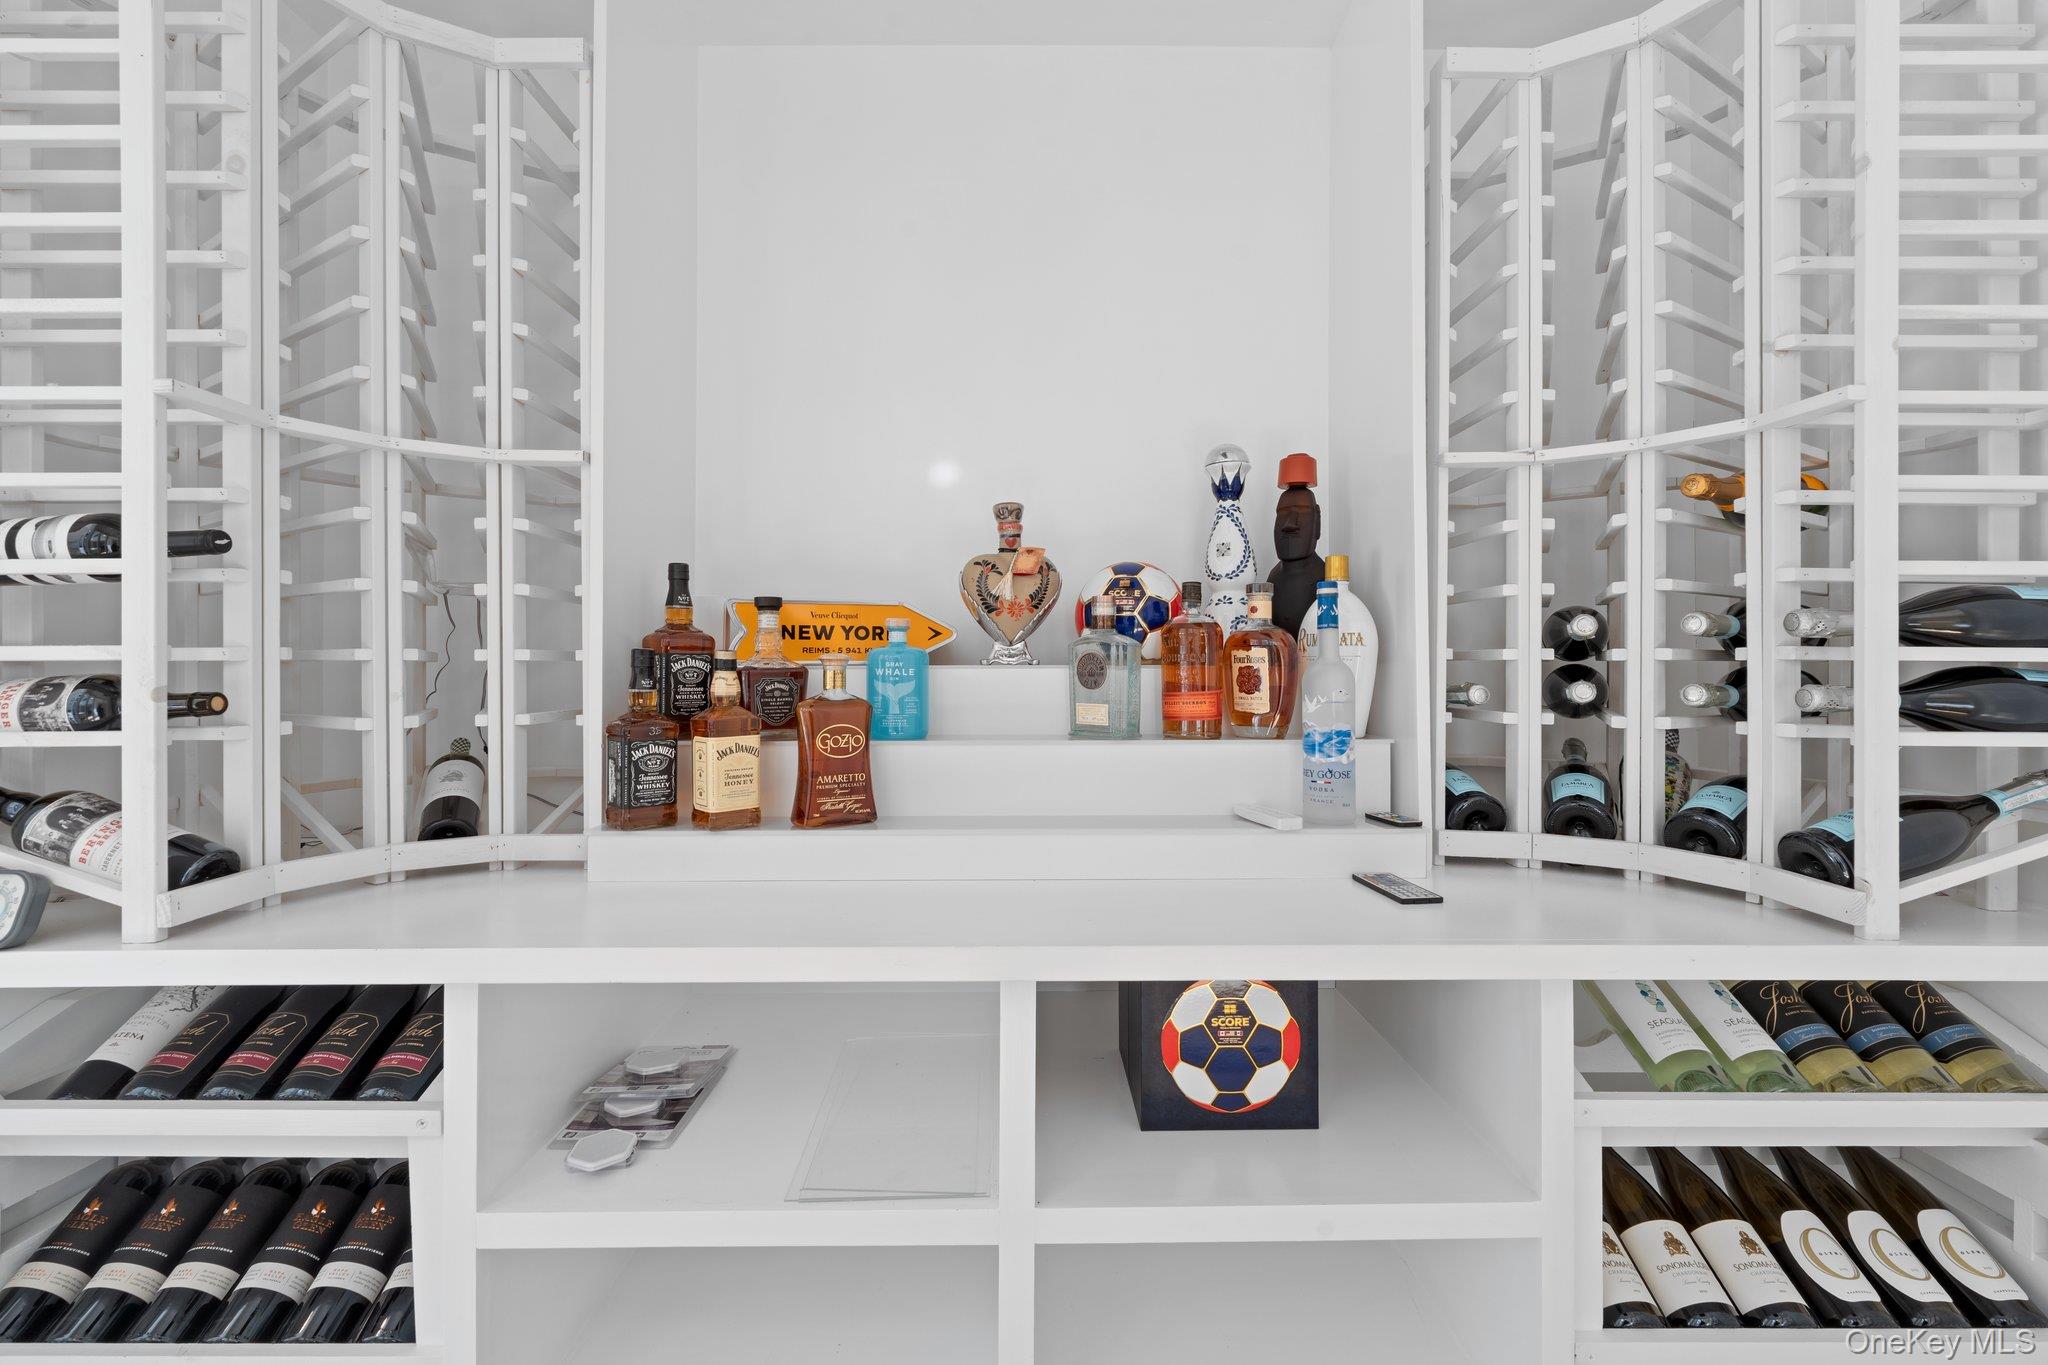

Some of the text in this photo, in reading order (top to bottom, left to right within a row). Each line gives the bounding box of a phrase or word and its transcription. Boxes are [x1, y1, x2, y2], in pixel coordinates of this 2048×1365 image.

[810, 611, 859, 620] Veuve Clicquot
[781, 624, 835, 640] NEW
[671, 659, 687, 672] JACK
[875, 668, 916, 676] WHALE
[630, 746, 650, 761] JACK
[716, 746, 735, 761] JACK
[816, 773, 866, 784] AMARETTO
[1317, 768, 1352, 779] GOOSE
[636, 782, 670, 790] WHISKEY
[724, 779, 754, 787] HONEY
[78, 818, 122, 865] BERING
[1211, 1017, 1250, 1027] SCORE
